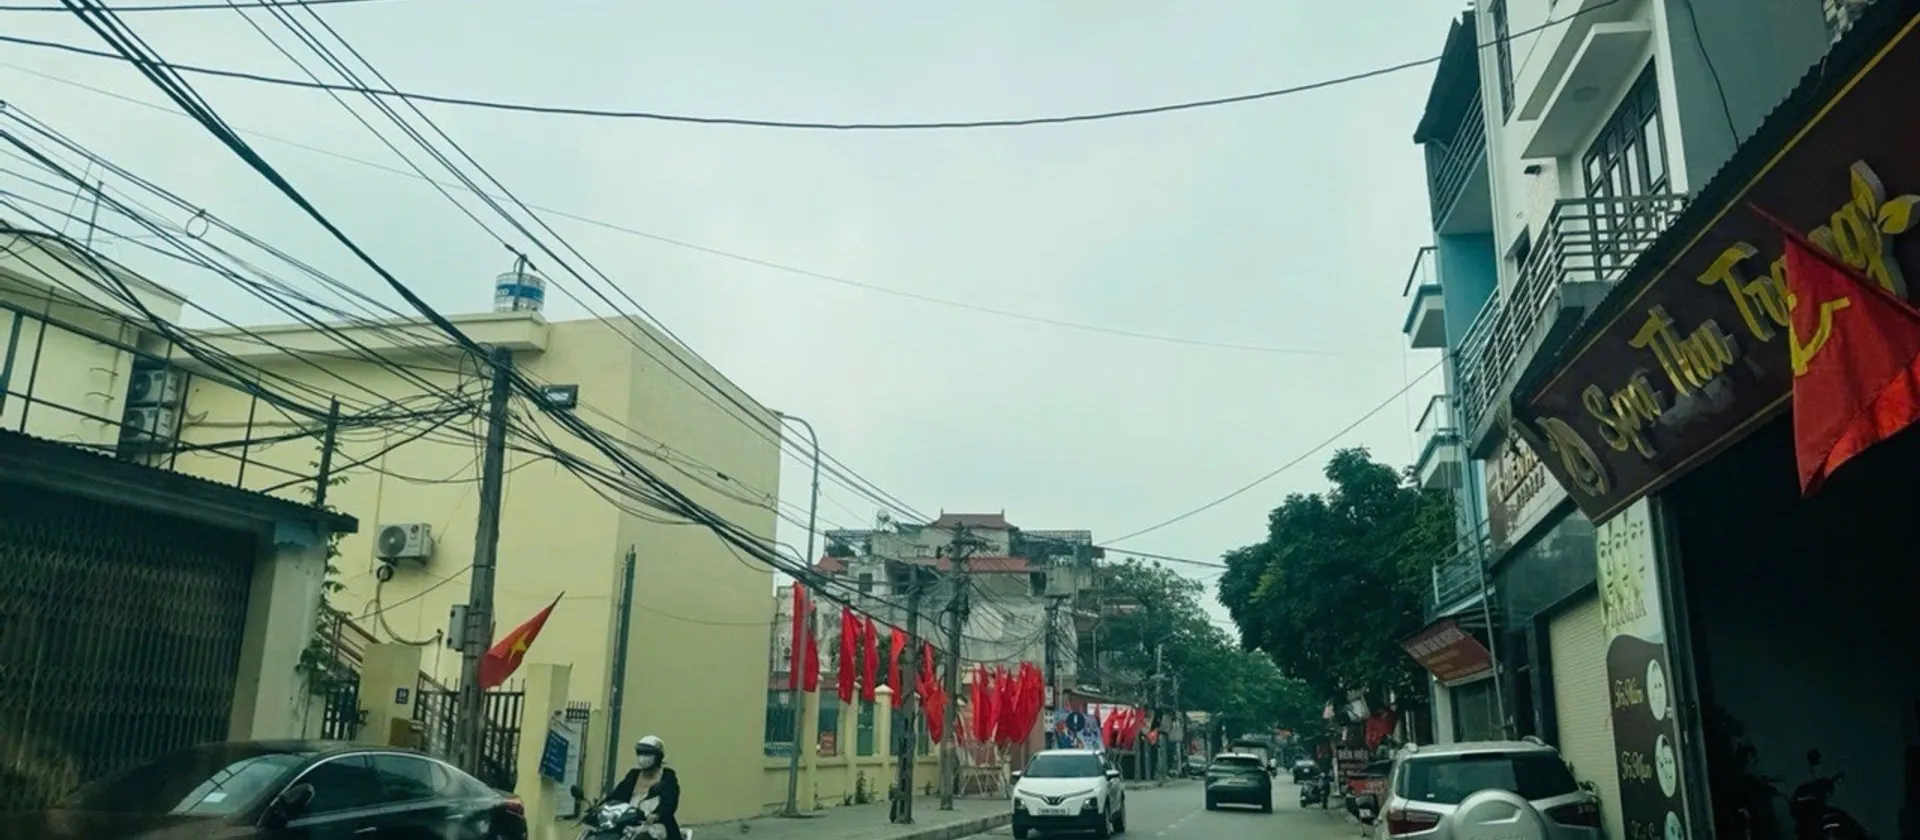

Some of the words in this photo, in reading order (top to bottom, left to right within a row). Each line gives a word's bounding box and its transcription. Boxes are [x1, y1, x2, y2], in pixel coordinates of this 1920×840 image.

[1581, 370, 1663, 460] Spa
[1628, 304, 1738, 397] Thu
[1696, 200, 1908, 343] Trg
